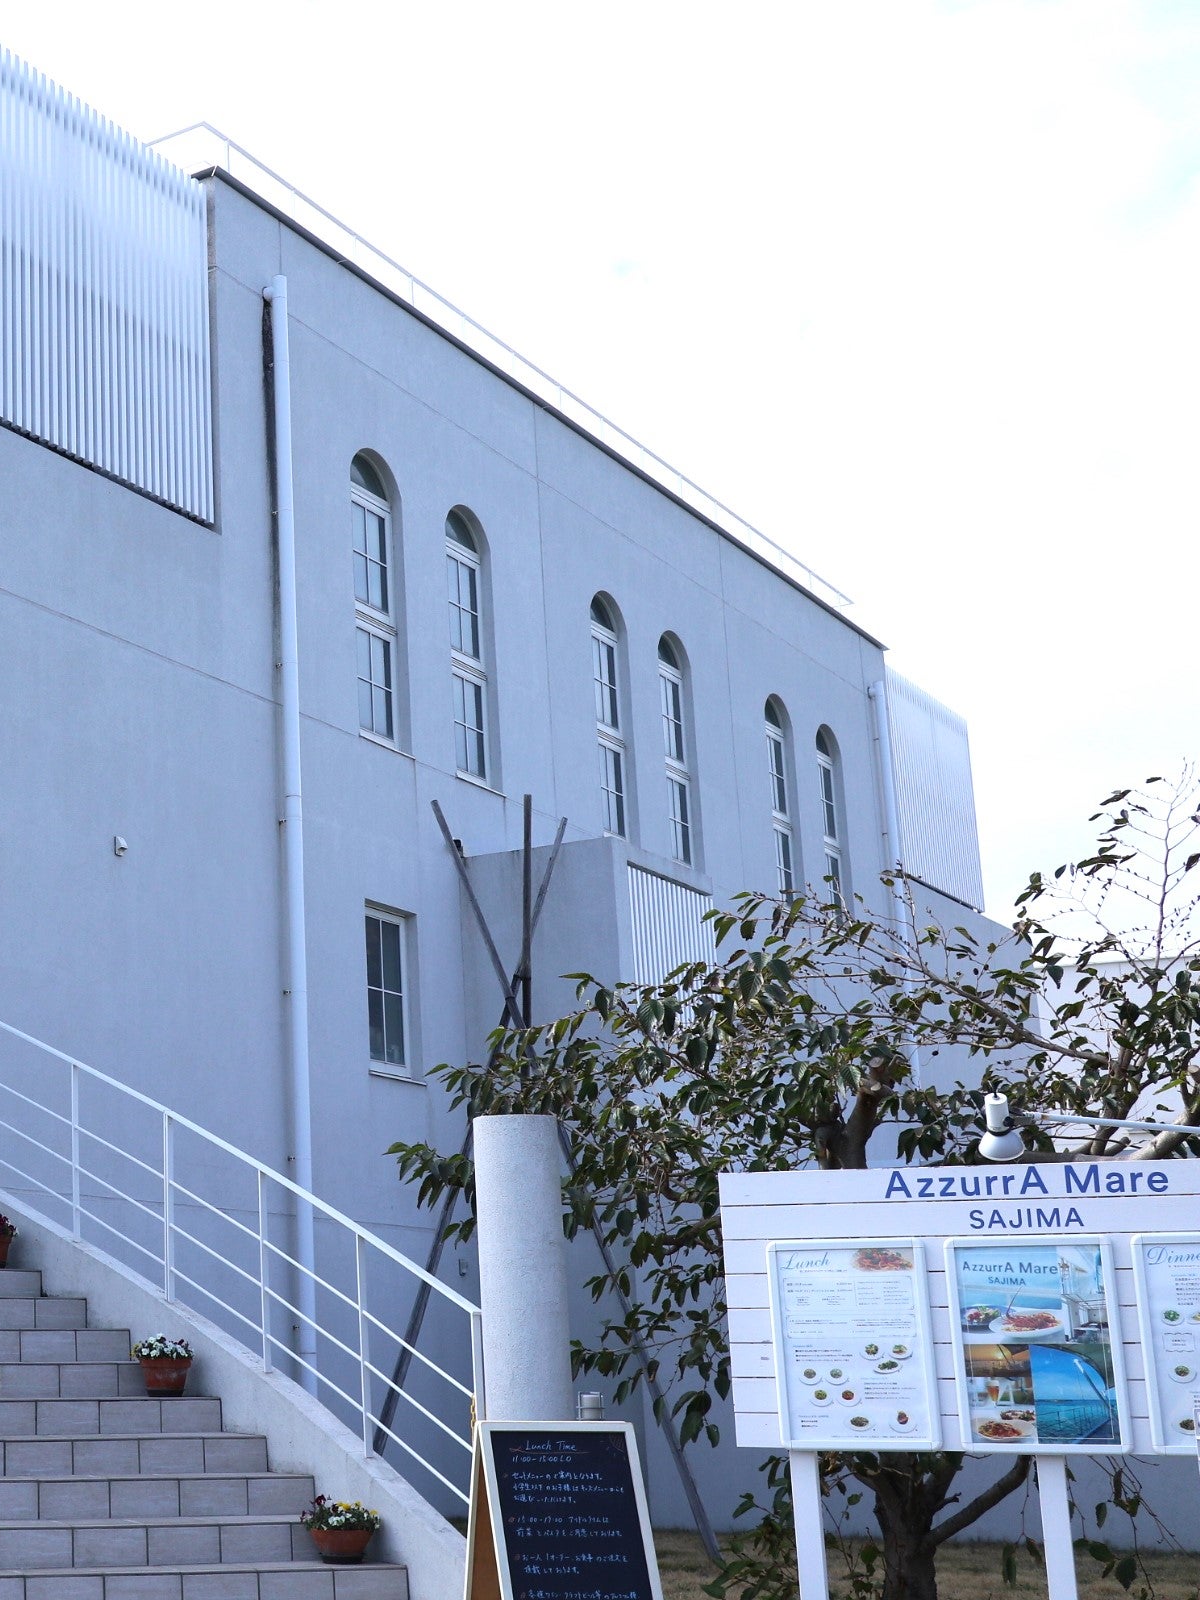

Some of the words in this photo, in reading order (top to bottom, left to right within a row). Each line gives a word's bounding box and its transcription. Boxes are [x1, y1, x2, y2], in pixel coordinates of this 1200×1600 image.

[884, 1165, 1049, 1199] AzzurrA
[1063, 1164, 1169, 1194] Mare
[969, 1207, 1085, 1230] SAJIMA
[780, 1251, 830, 1270] Lunch
[962, 1261, 1014, 1273] AzzurrA
[1019, 1262, 1058, 1274] Mare
[988, 1276, 1026, 1286] SAJIMA
[525, 1440, 552, 1451] Lunch
[556, 1440, 577, 1451] Time
